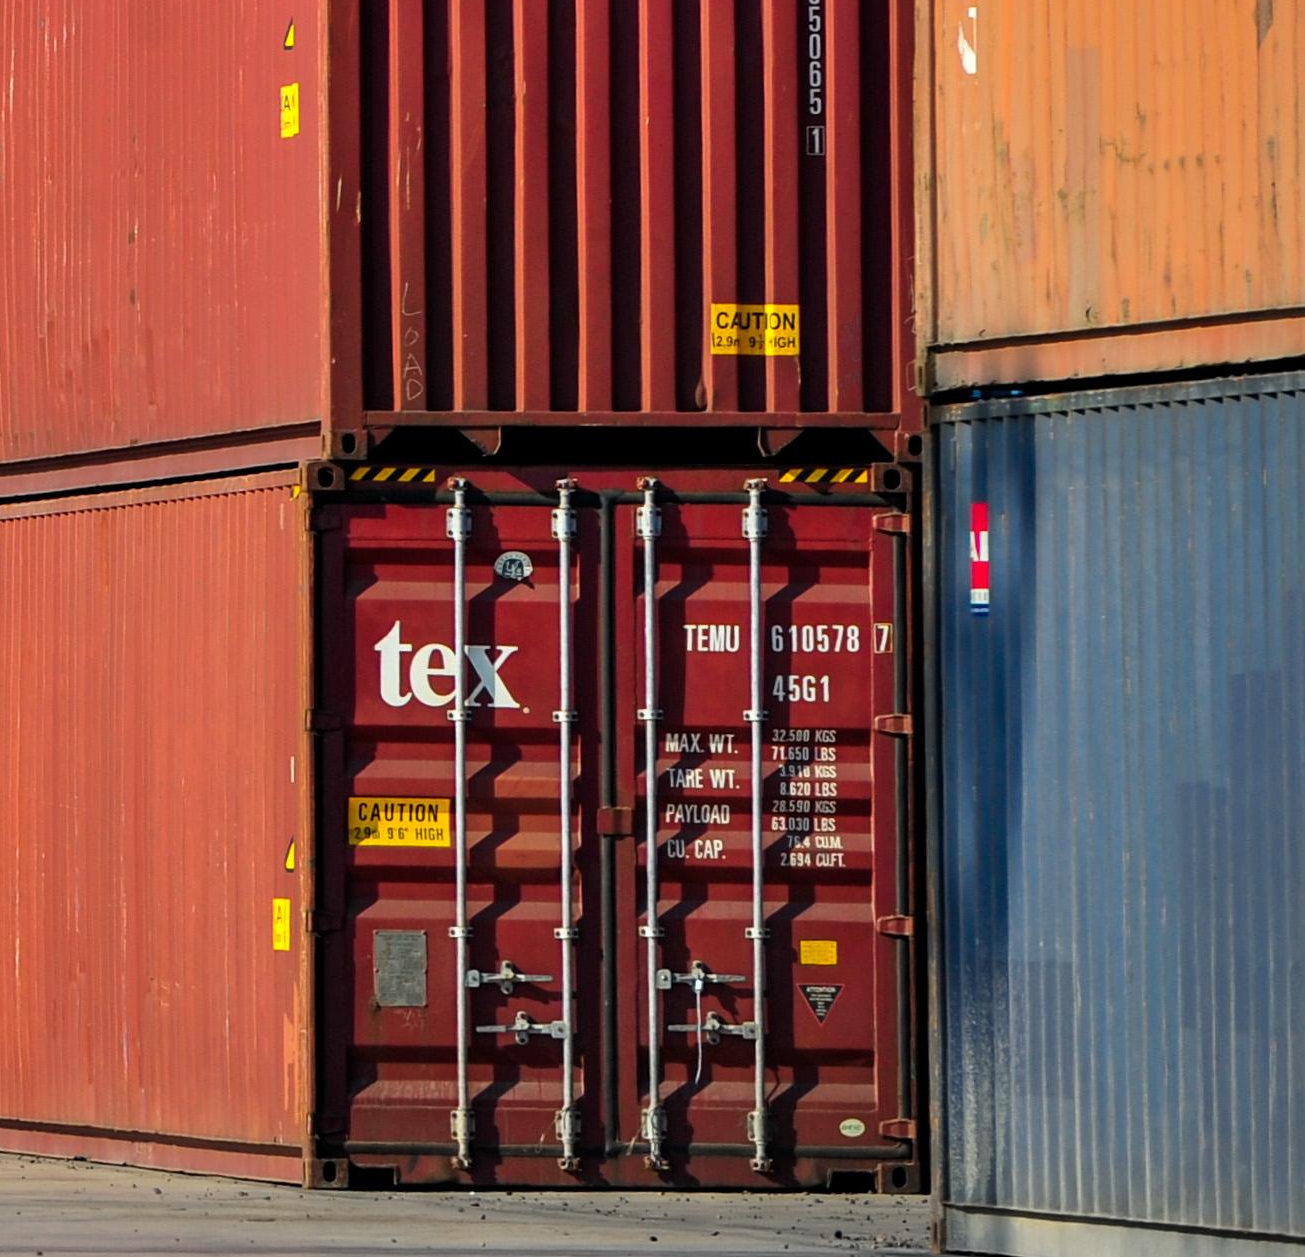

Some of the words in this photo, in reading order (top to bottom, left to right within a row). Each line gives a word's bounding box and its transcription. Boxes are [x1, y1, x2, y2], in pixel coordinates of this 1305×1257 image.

[809, 127, 824, 154] 1
[716, 311, 795, 331] CAUTION
[683, 624, 740, 653] TEMU
[771, 624, 860, 653] 610578
[876, 625, 891, 652] 7
[772, 675, 830, 702] 45G1
[665, 733, 705, 753] MAX.
[709, 734, 739, 754] WT.
[815, 729, 837, 743] KGS
[814, 746, 837, 761] LBS
[667, 768, 703, 789] TARE
[710, 769, 740, 789] WT.
[815, 765, 837, 779] KGS
[814, 782, 837, 796] LBS
[358, 802, 439, 822] CAUTION
[665, 804, 731, 825] PAYLOAD
[815, 800, 837, 814] KGS
[415, 827, 444, 841] HIGH
[814, 818, 836, 832] LBS
[667, 839, 690, 859] CU.
[694, 839, 726, 859] CAP.
